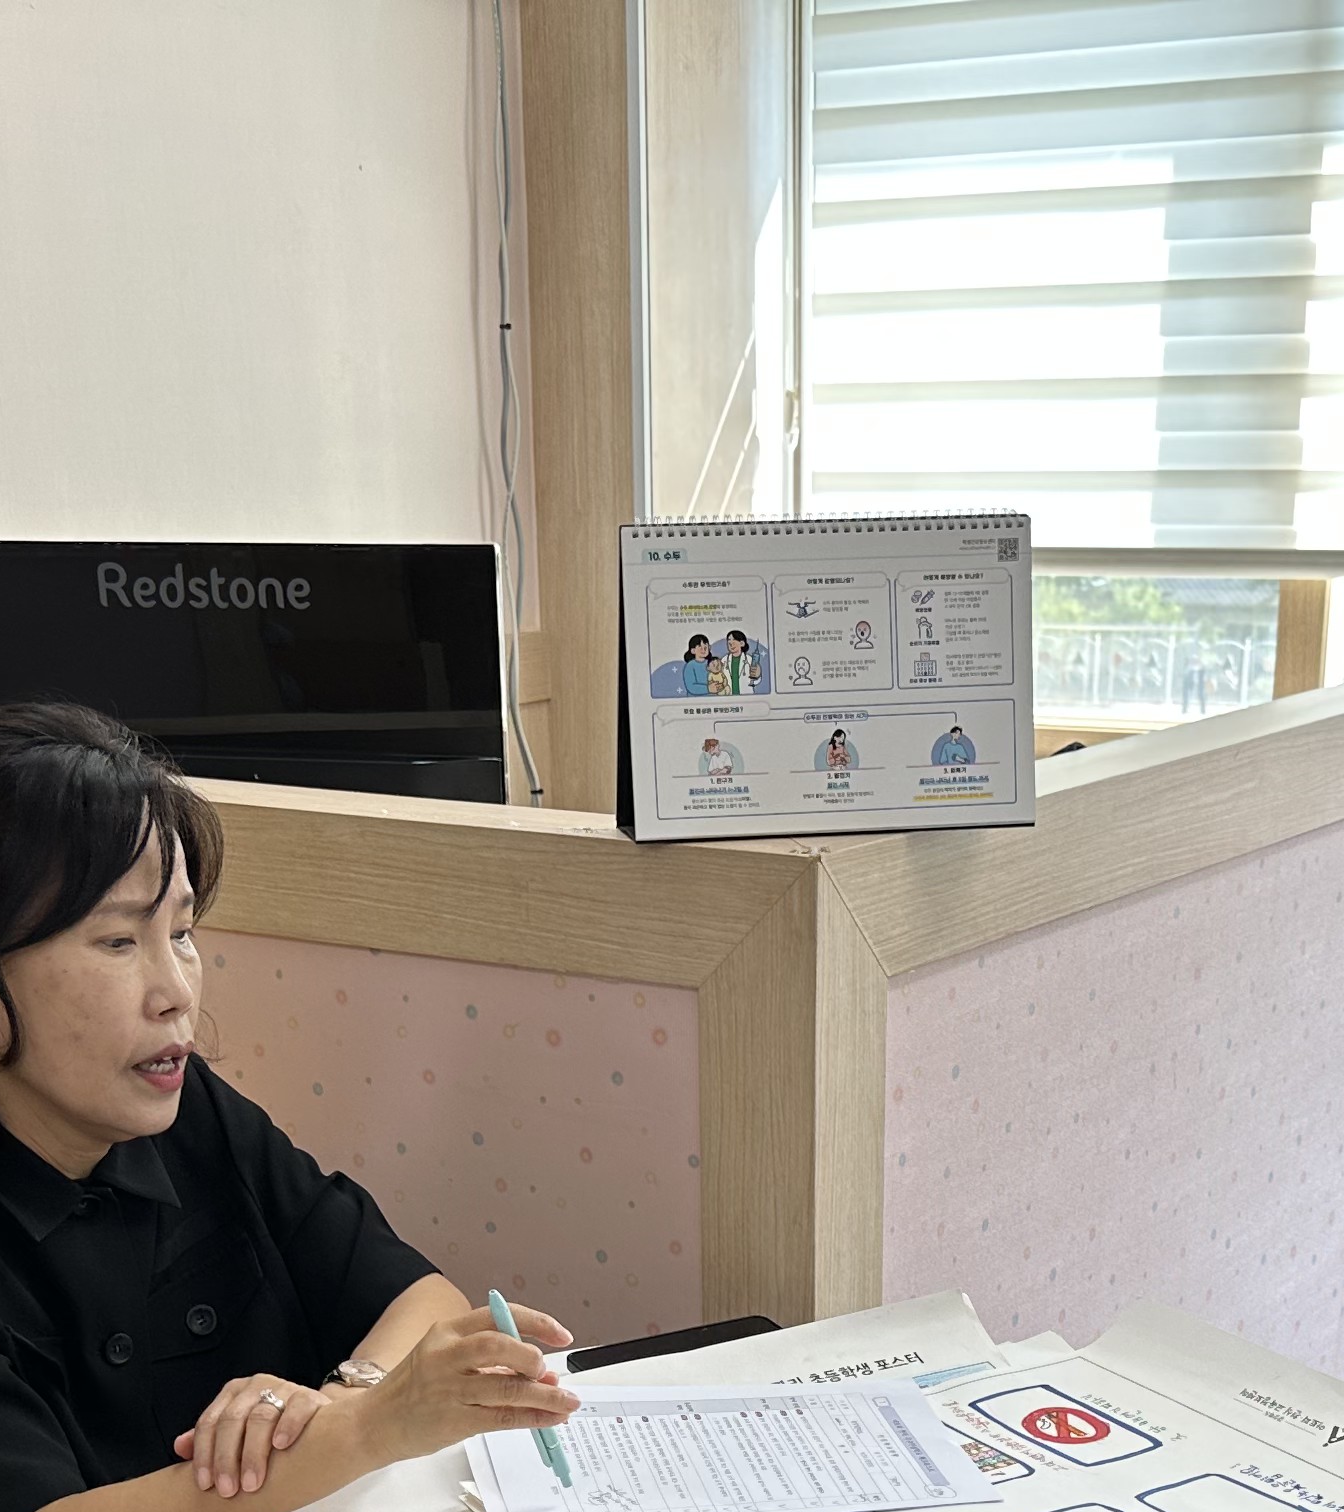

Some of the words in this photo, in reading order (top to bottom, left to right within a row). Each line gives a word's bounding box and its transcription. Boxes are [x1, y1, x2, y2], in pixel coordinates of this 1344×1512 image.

[648, 551, 661, 561] 10.
[664, 551, 681, 560] 수두
[96, 562, 312, 610] Redstone
[809, 1362, 873, 1383] 초등학생
[874, 1352, 924, 1371] 포스터
